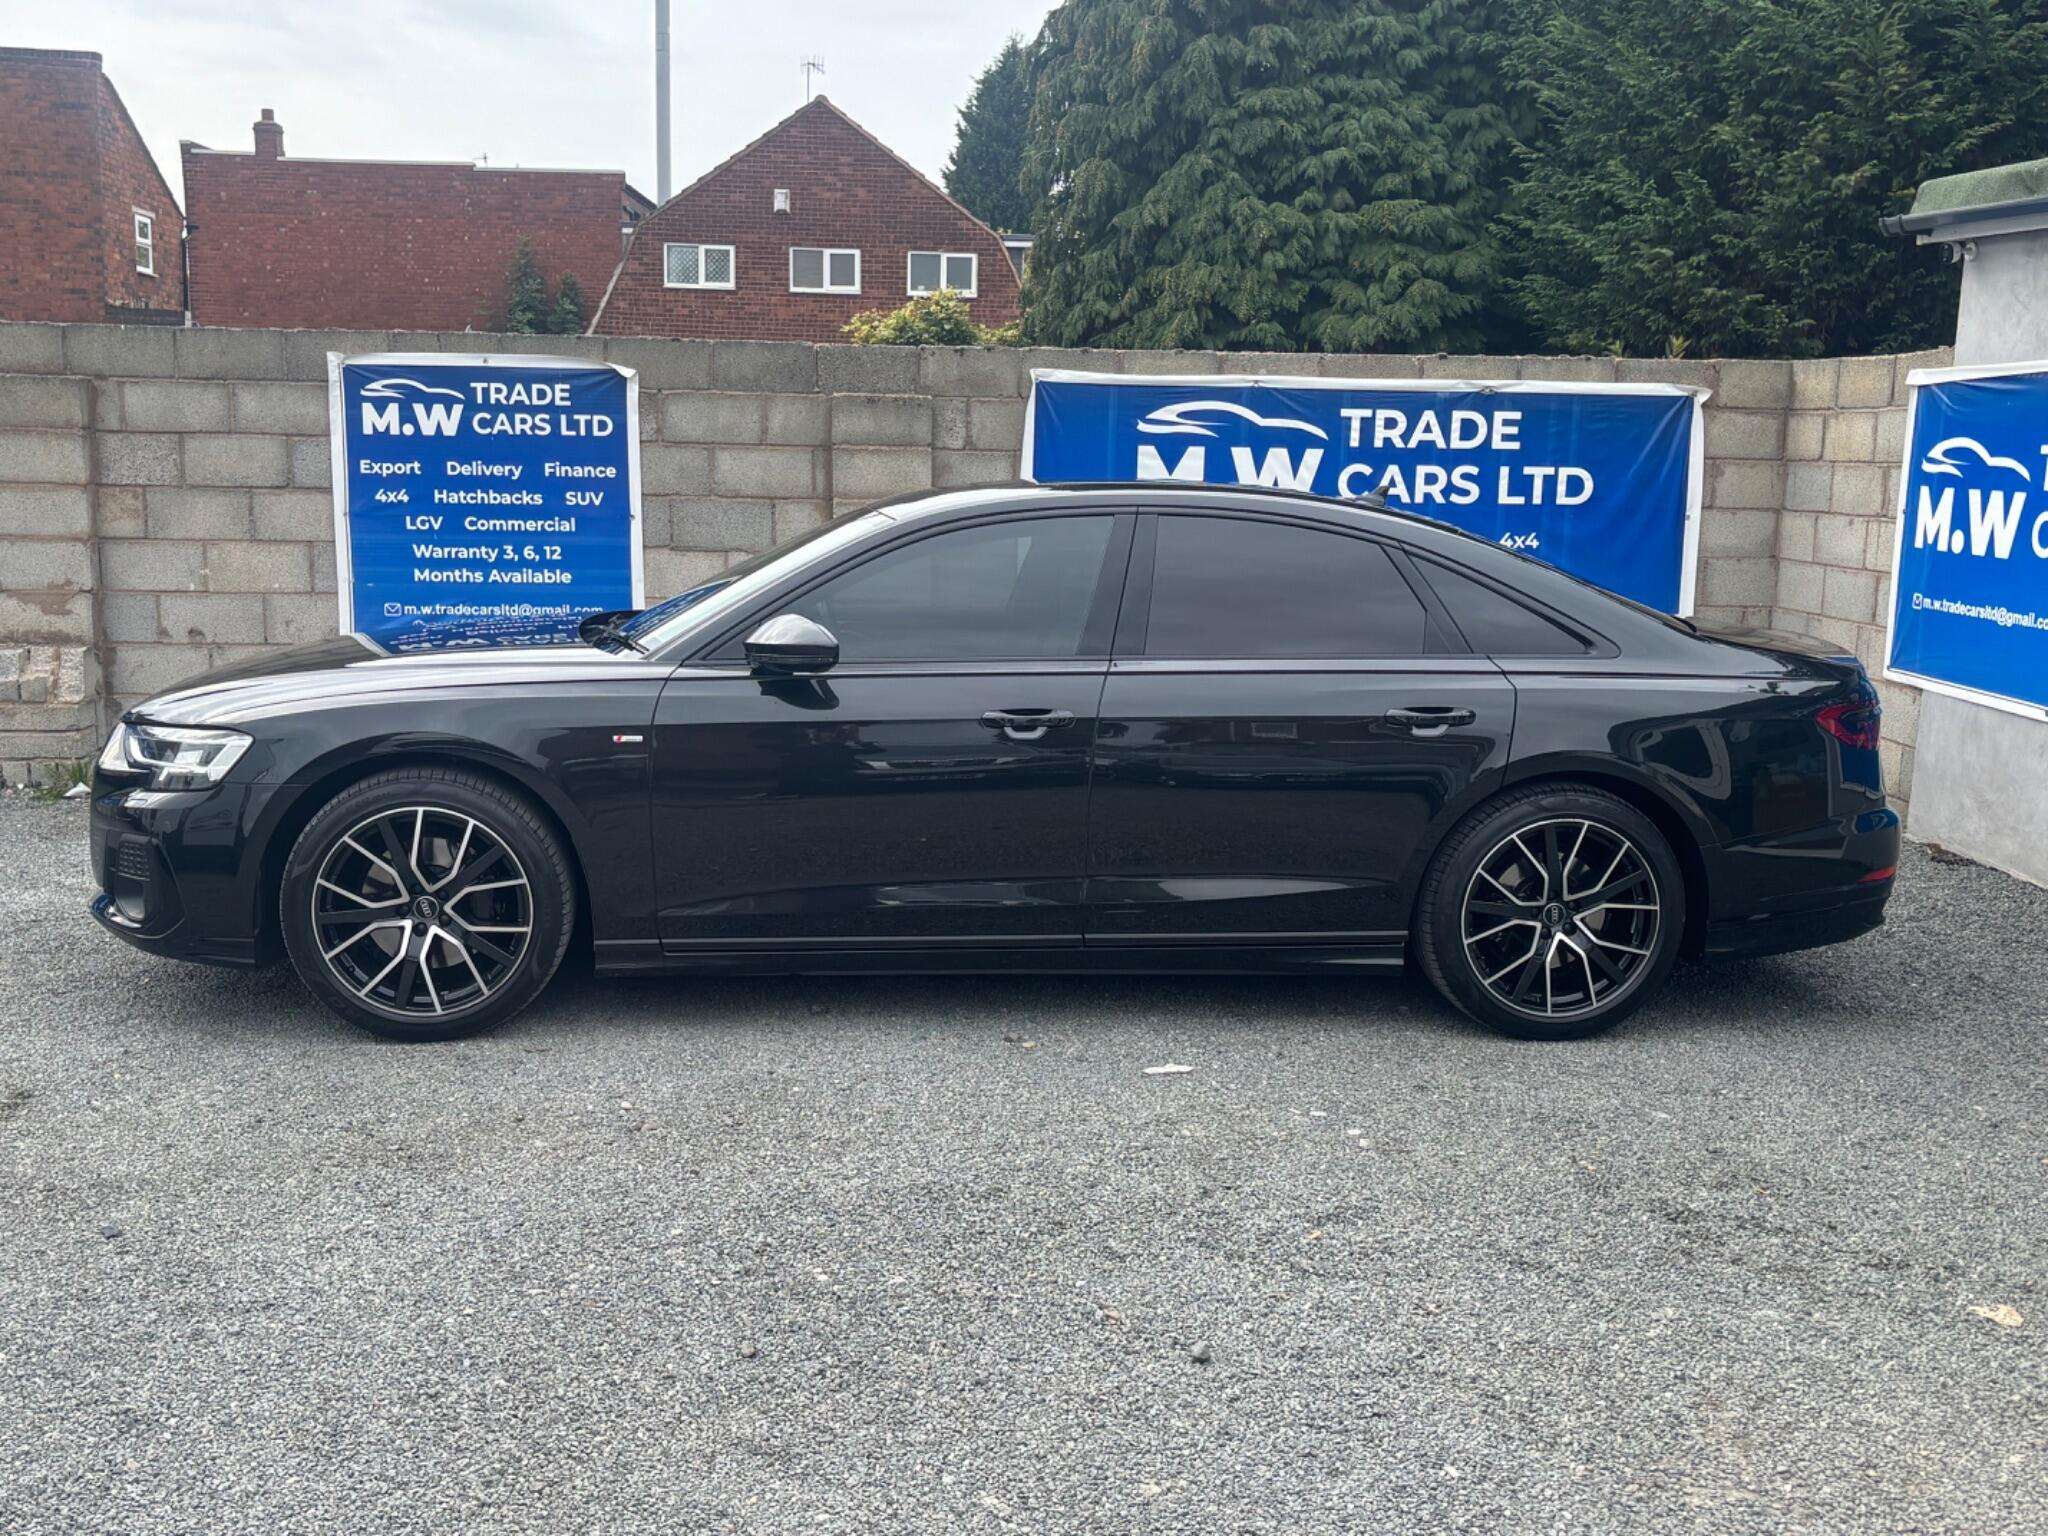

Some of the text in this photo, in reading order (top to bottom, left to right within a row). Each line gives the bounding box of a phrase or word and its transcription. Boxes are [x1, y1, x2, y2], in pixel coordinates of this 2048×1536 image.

[470, 382, 571, 406] TRADE
[361, 402, 464, 436] M.W
[472, 413, 613, 437] CARS LTD
[1341, 408, 1522, 450] TRADE
[360, 460, 617, 480] Export Delivery Finance
[1137, 446, 1325, 493] MW
[1337, 463, 1595, 505] CARS LTD
[375, 489, 604, 506] 4x4 Hatchbacks SUV
[405, 516, 576, 532] LGV Commercial
[1914, 485, 2027, 560] M.W
[1500, 532, 1540, 549] 4x4
[412, 545, 562, 563] Warranty 3, 6, 12
[414, 569, 572, 584] Months Available
[404, 603, 604, 617] m.w.tradecarsltd@gmailcom
